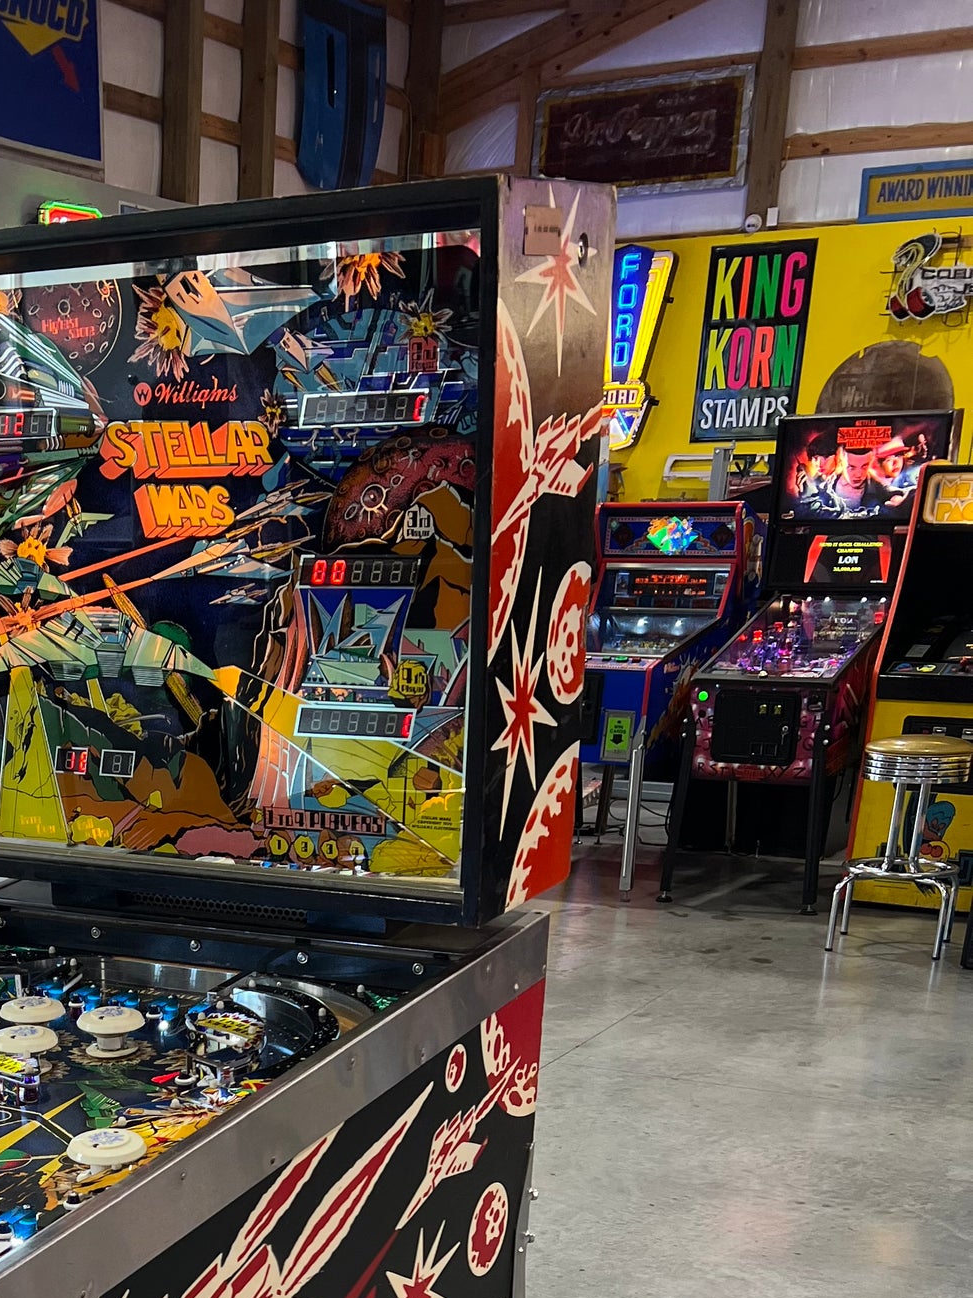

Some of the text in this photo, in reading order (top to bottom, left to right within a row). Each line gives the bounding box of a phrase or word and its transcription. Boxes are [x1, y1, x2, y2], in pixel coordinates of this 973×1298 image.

[876, 178, 925, 203] AWARD
[711, 251, 808, 321] KING
[613, 253, 642, 367] FORD
[704, 324, 800, 391] KORN
[154, 379, 239, 405] Williams
[604, 390, 639, 405] ORD
[700, 395, 790, 430] STAMPS
[100, 420, 273, 479] STELLAR
[134, 484, 235, 538] WARS
[407, 510, 431, 528] 3rd
[308, 811, 385, 835] PLAYERS
